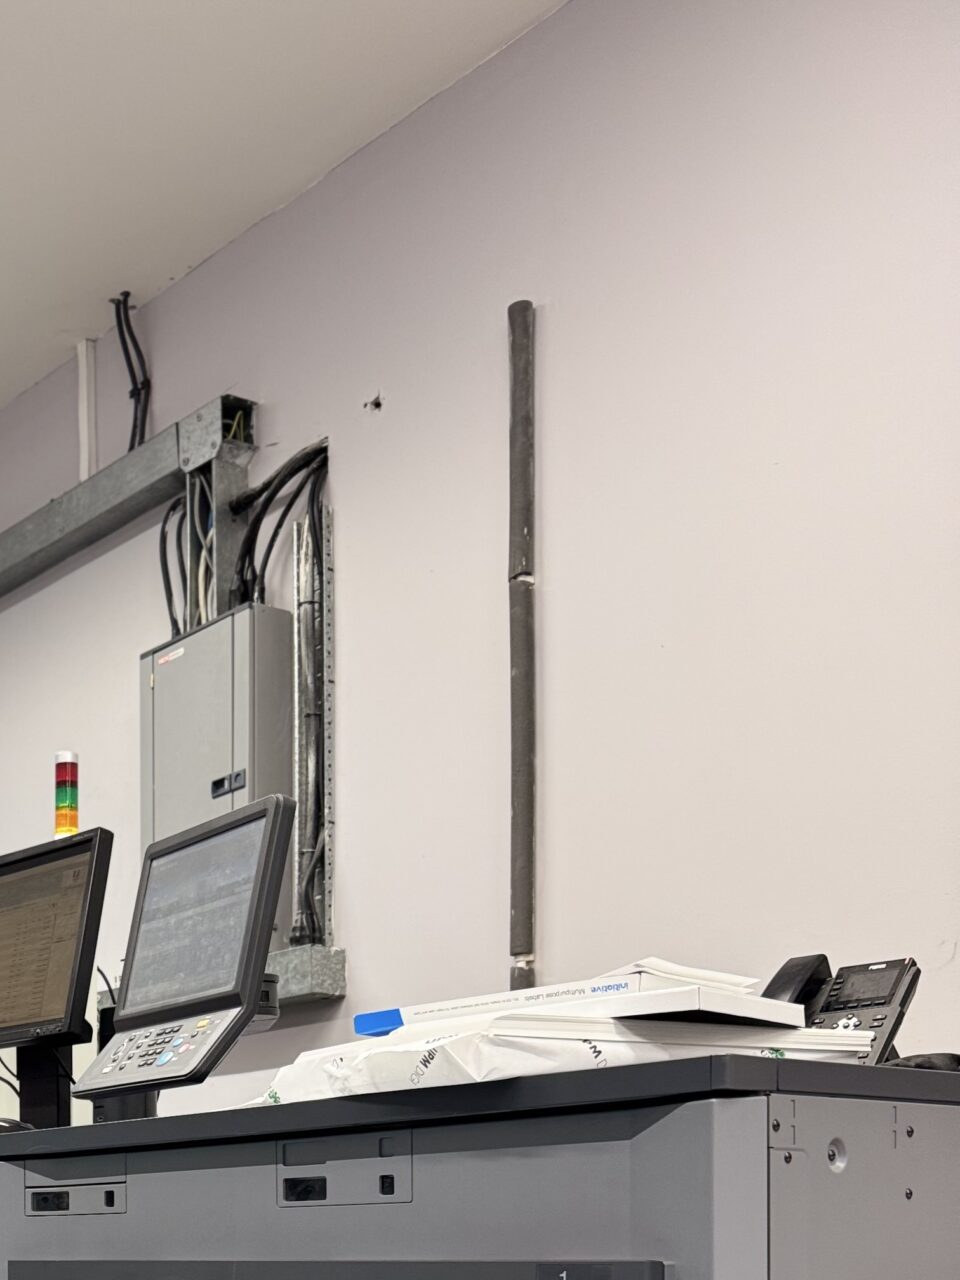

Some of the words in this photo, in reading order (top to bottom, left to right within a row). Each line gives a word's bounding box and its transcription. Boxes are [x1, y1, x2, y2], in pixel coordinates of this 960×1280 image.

[591, 982, 629, 993] initiative
[524, 993, 545, 1002] Labels
[545, 988, 586, 999] Multipurpose
